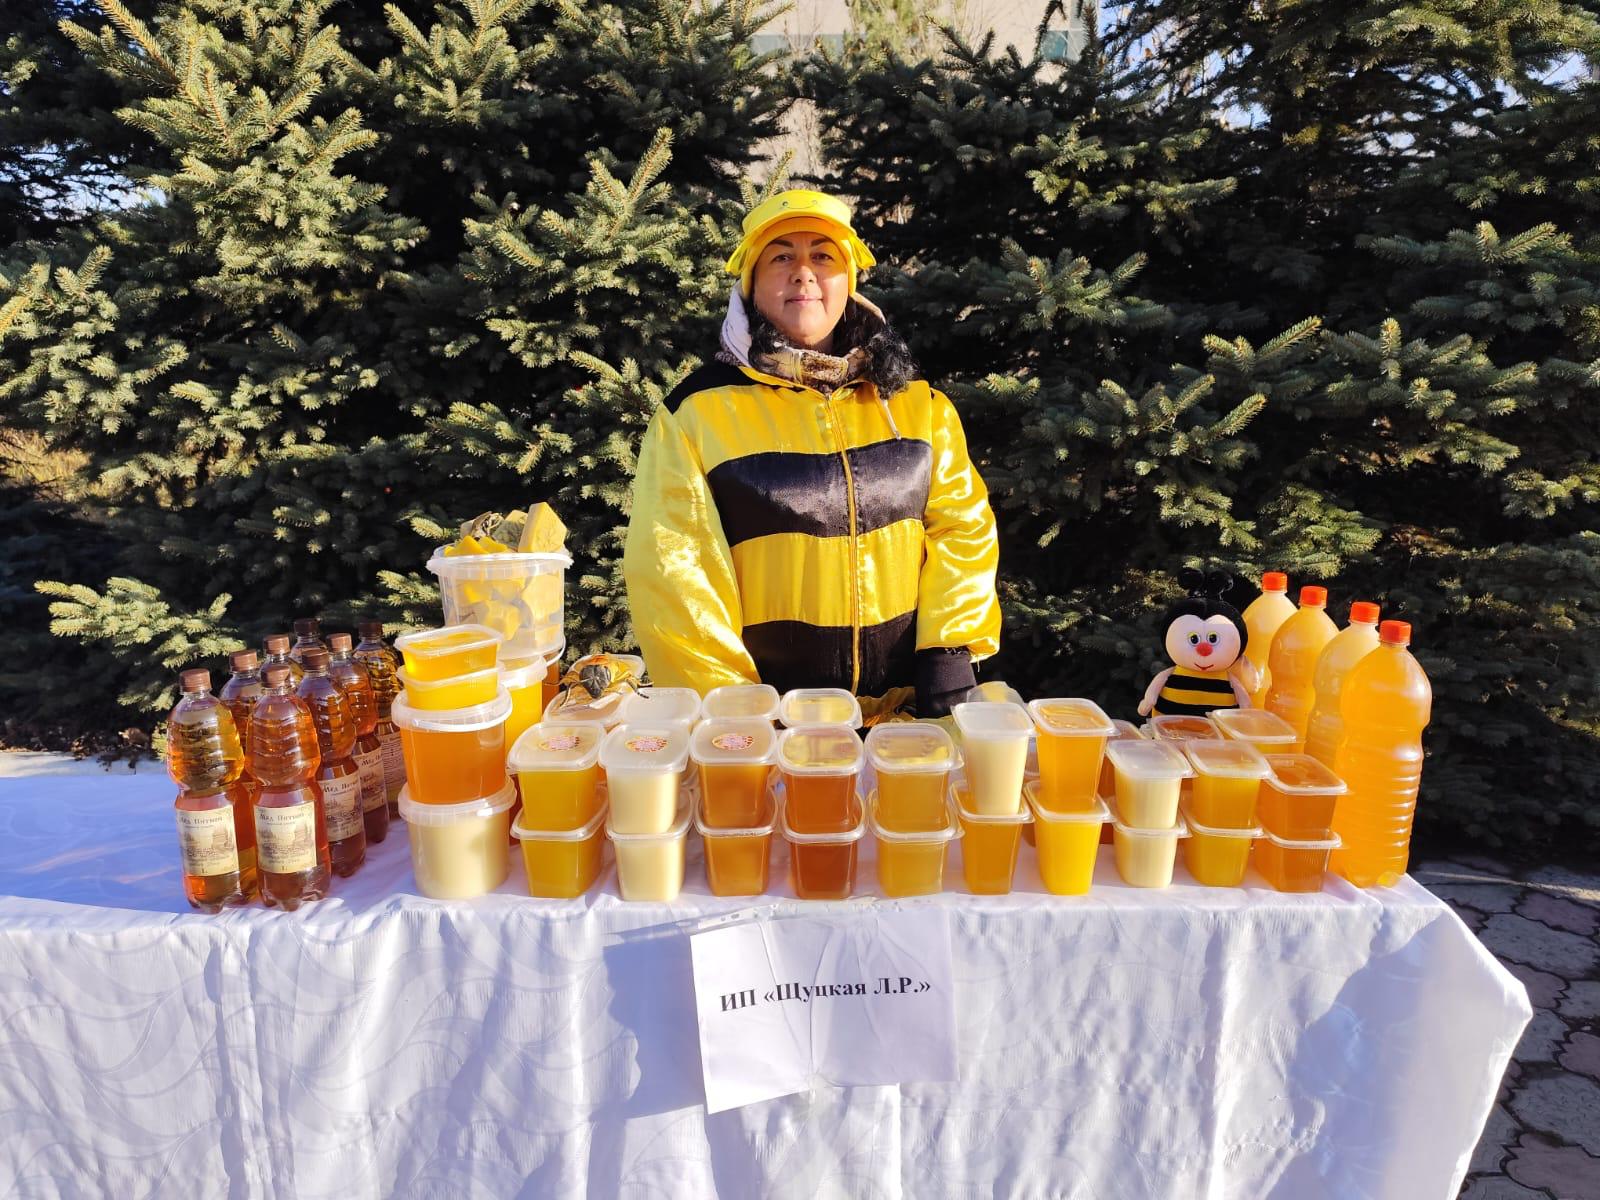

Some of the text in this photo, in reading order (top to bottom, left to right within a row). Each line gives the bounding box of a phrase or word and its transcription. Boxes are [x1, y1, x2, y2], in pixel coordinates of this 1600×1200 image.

[720, 977, 931, 1012] ИП «Щуцкая Л.Р.»
